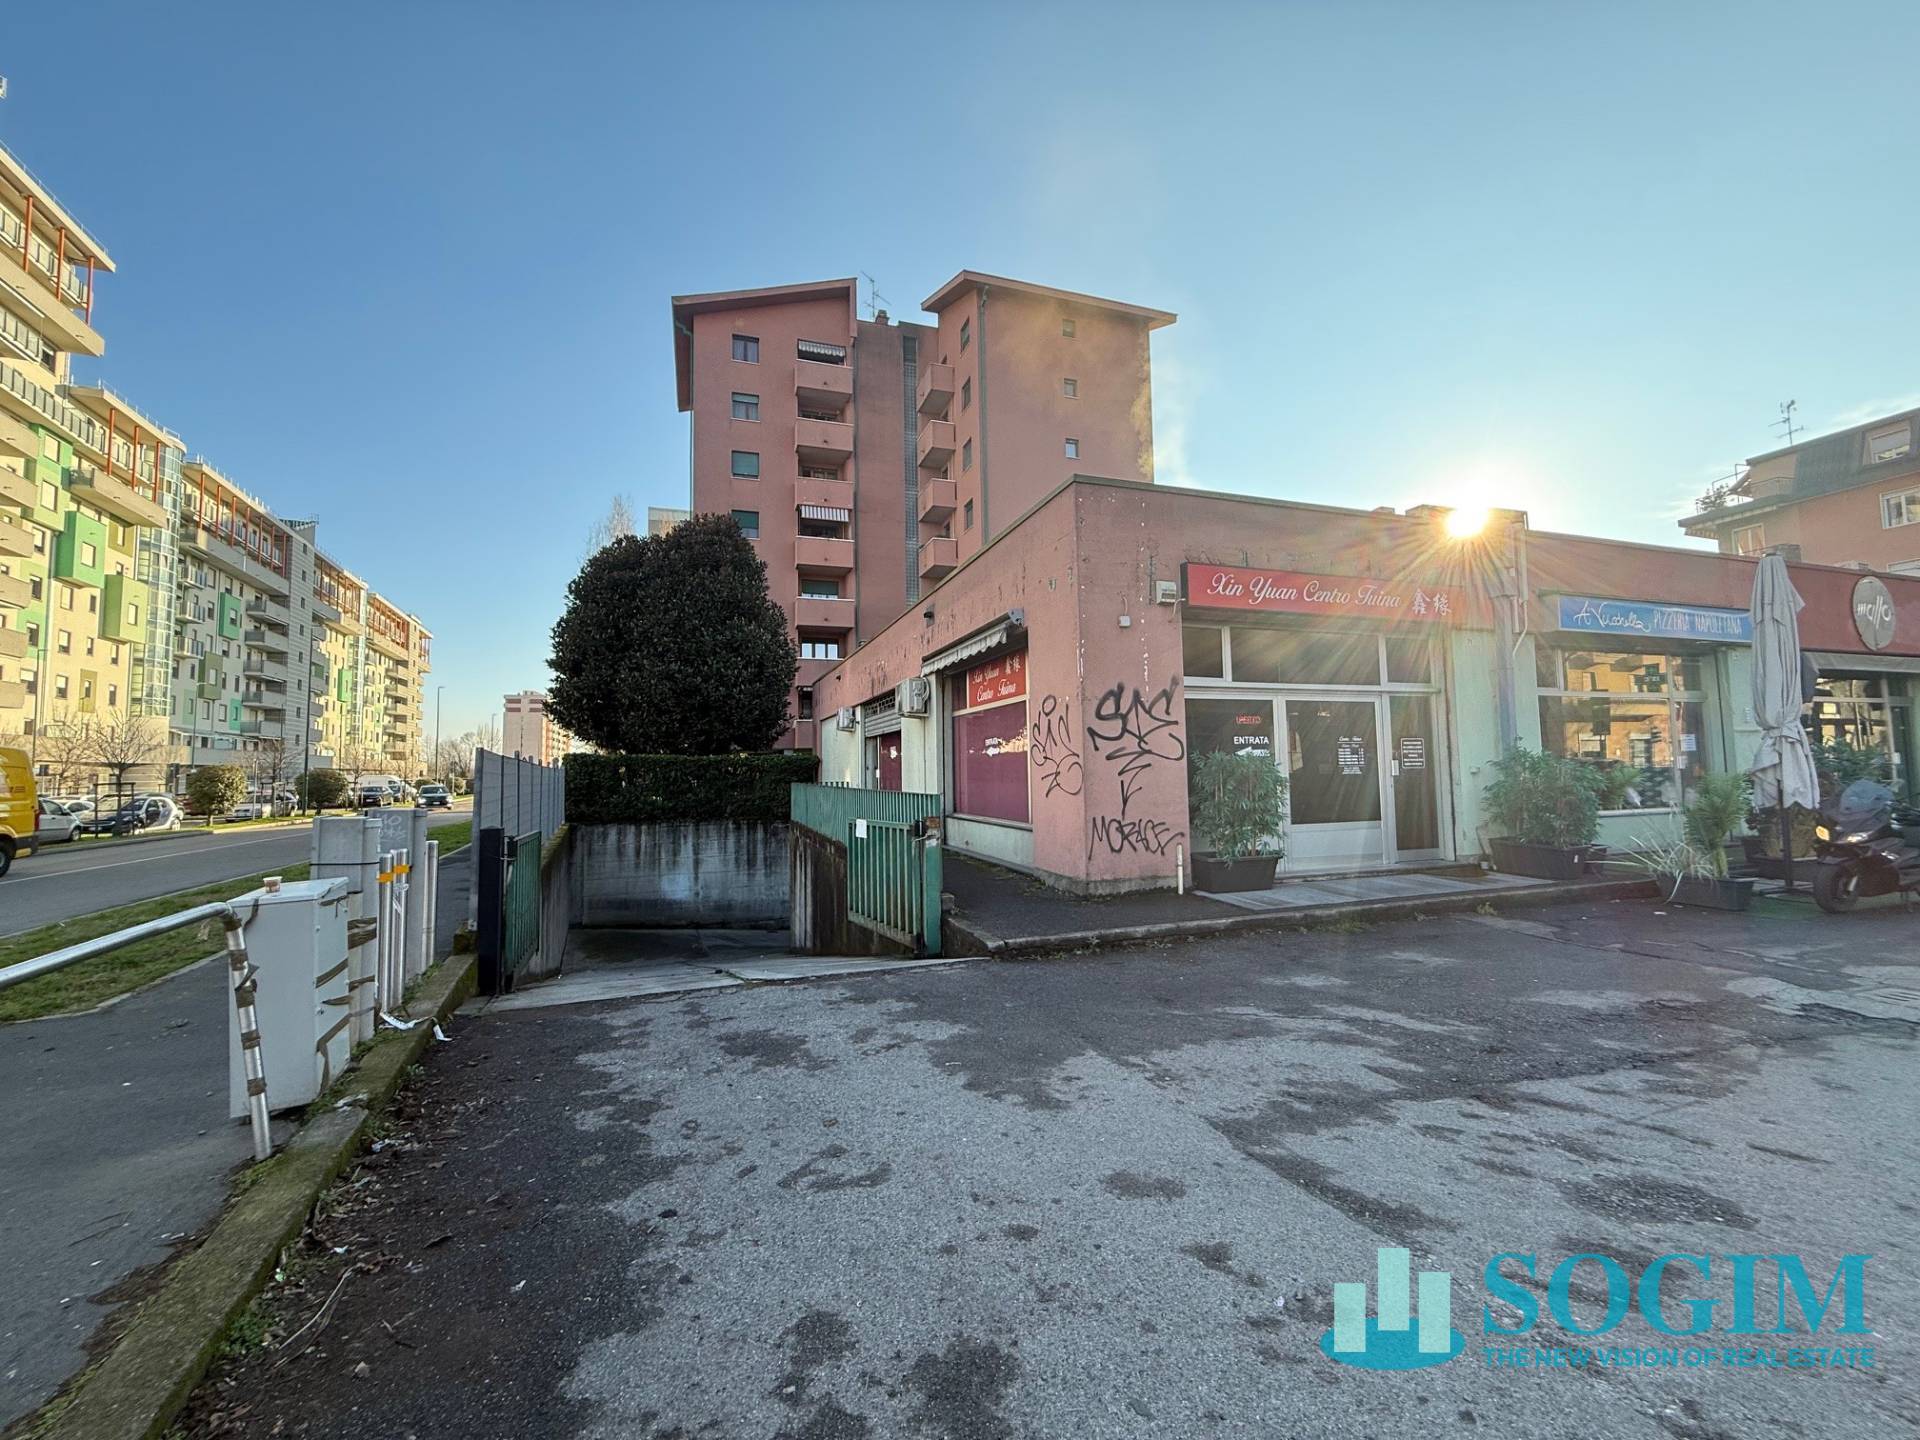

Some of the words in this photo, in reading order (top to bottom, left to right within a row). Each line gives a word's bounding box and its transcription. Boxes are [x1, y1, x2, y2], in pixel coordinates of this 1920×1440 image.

[1207, 572, 1244, 597] Xin
[1248, 576, 1298, 605] Yuan
[1303, 580, 1350, 605] Centro
[1355, 584, 1401, 608] Tuina
[1233, 736, 1270, 745] ENTRATA
